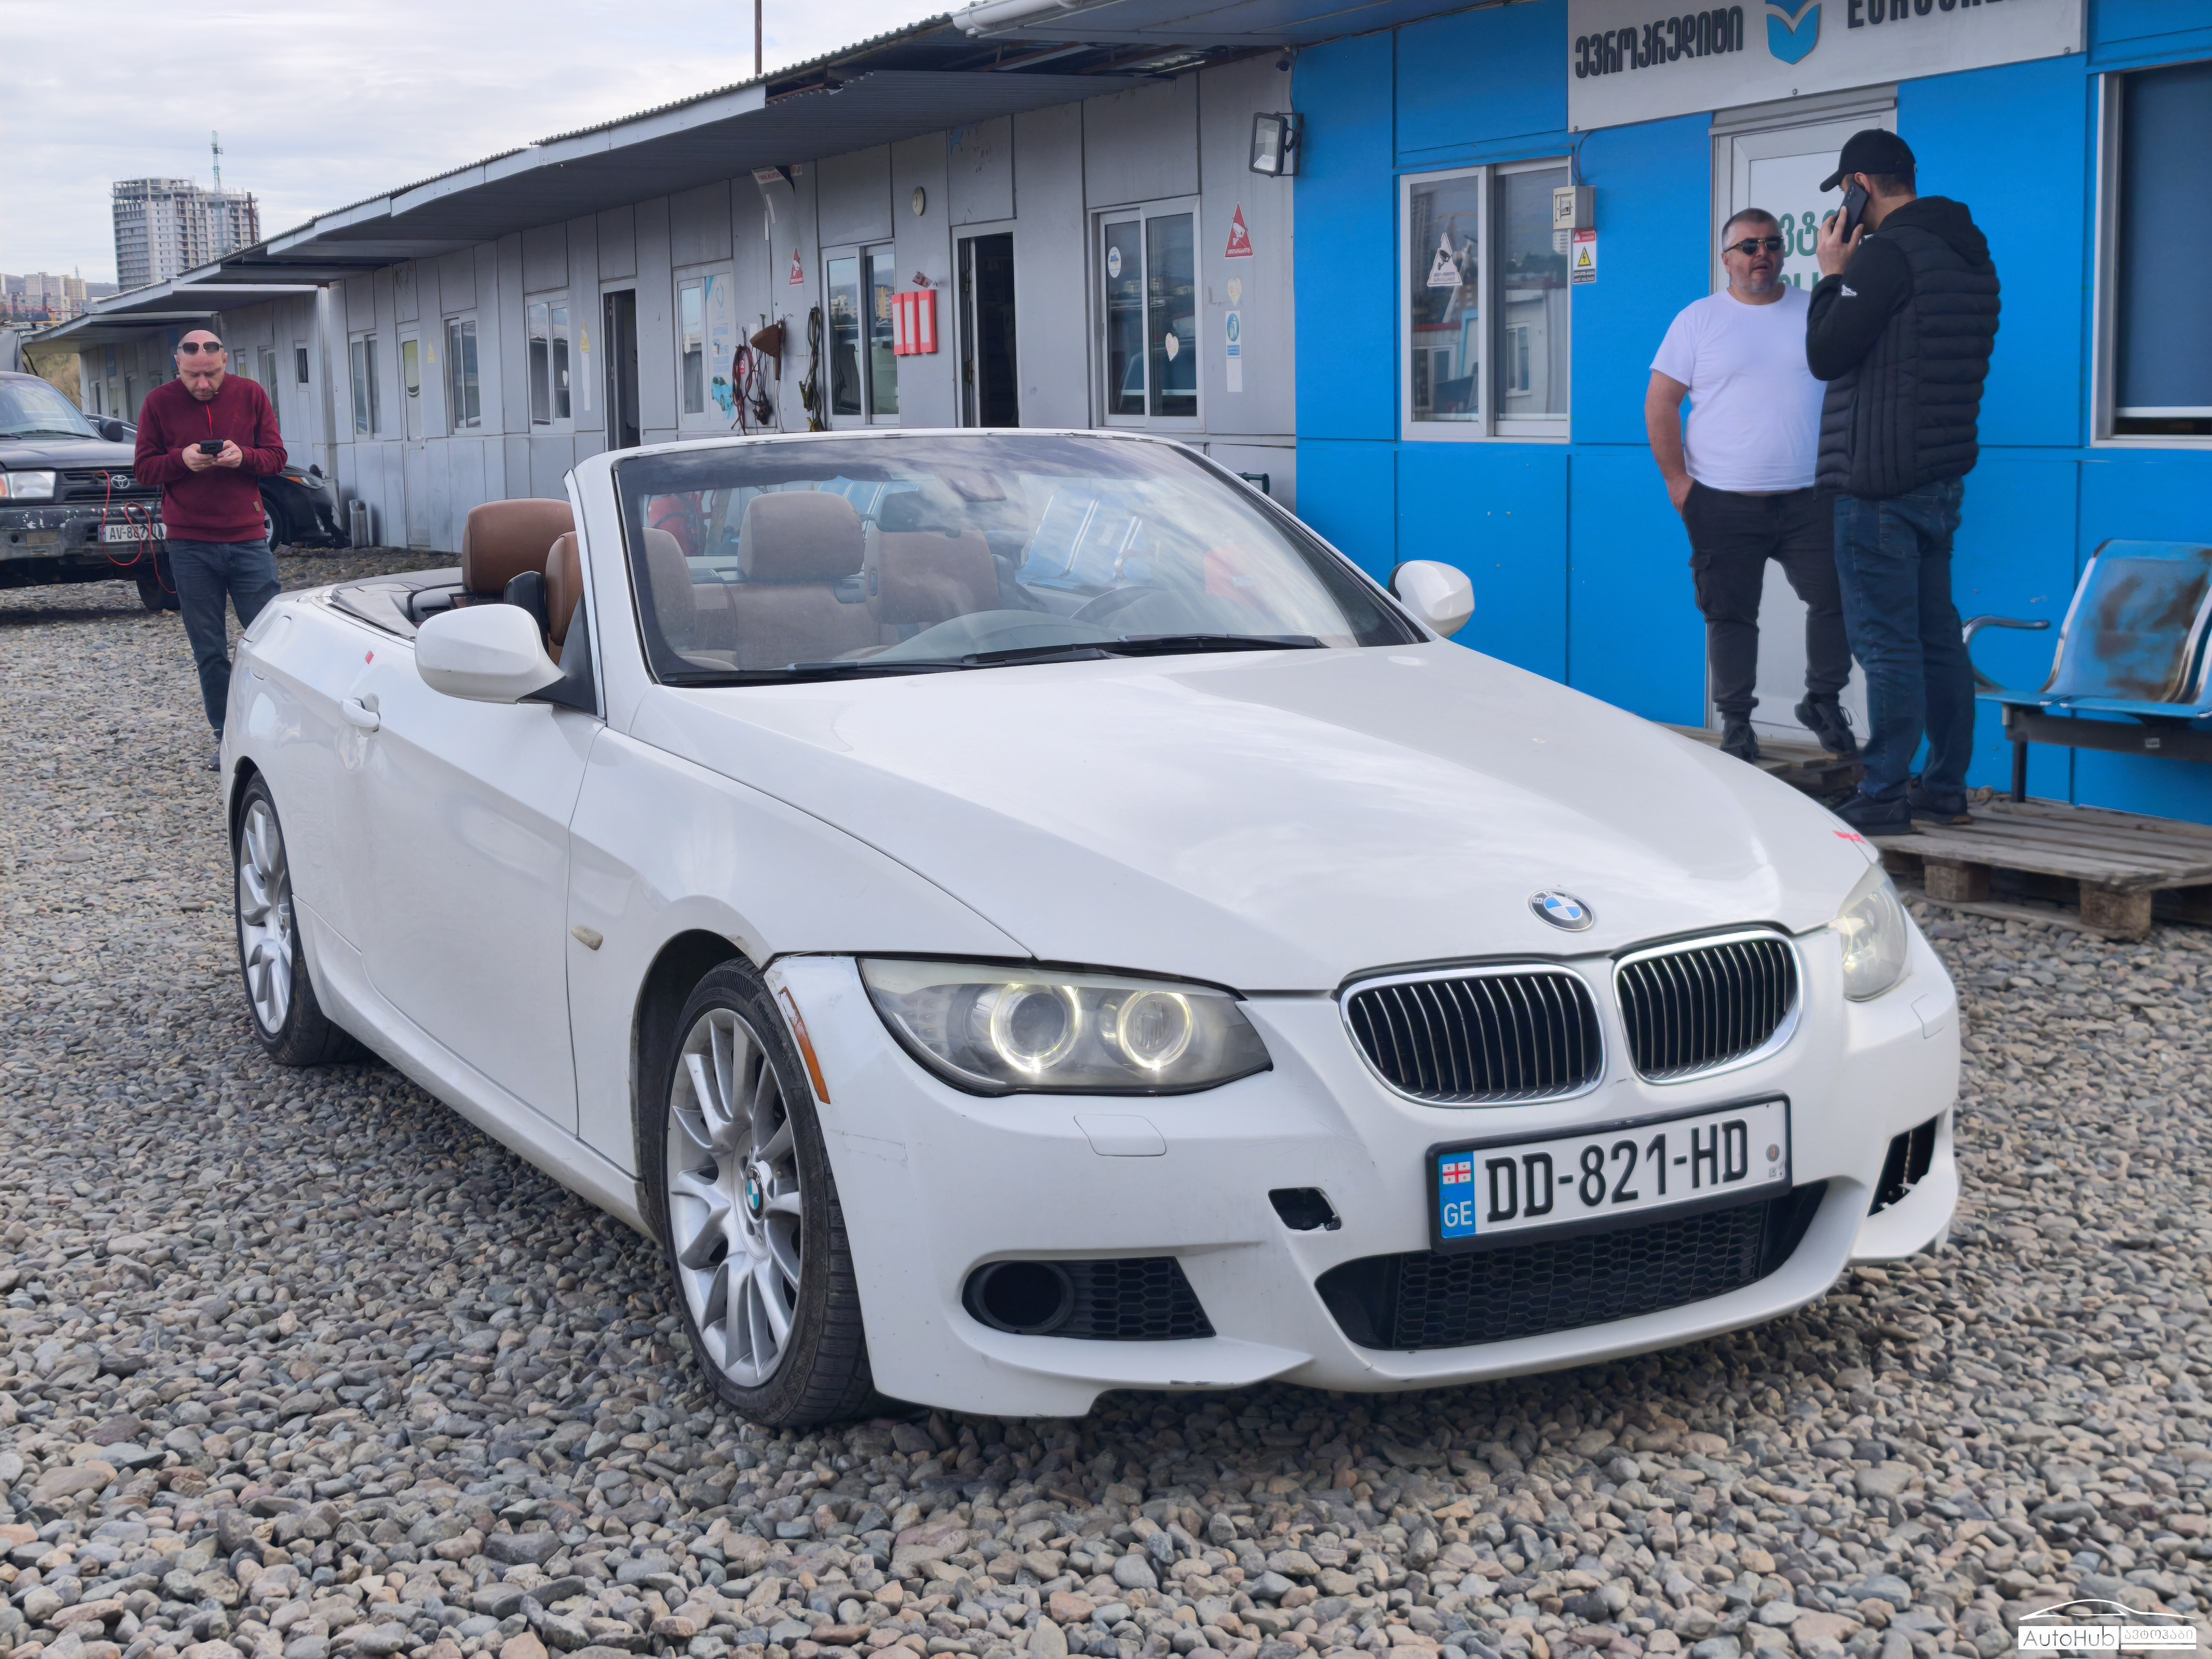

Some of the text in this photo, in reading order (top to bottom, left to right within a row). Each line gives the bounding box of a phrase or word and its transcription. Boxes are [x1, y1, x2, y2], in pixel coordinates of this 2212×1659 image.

[1575, 5, 1743, 78] ევროკრედიტი
[1485, 1118, 1748, 1222] DD-821-HD
[1444, 1200, 1473, 1228] GE
